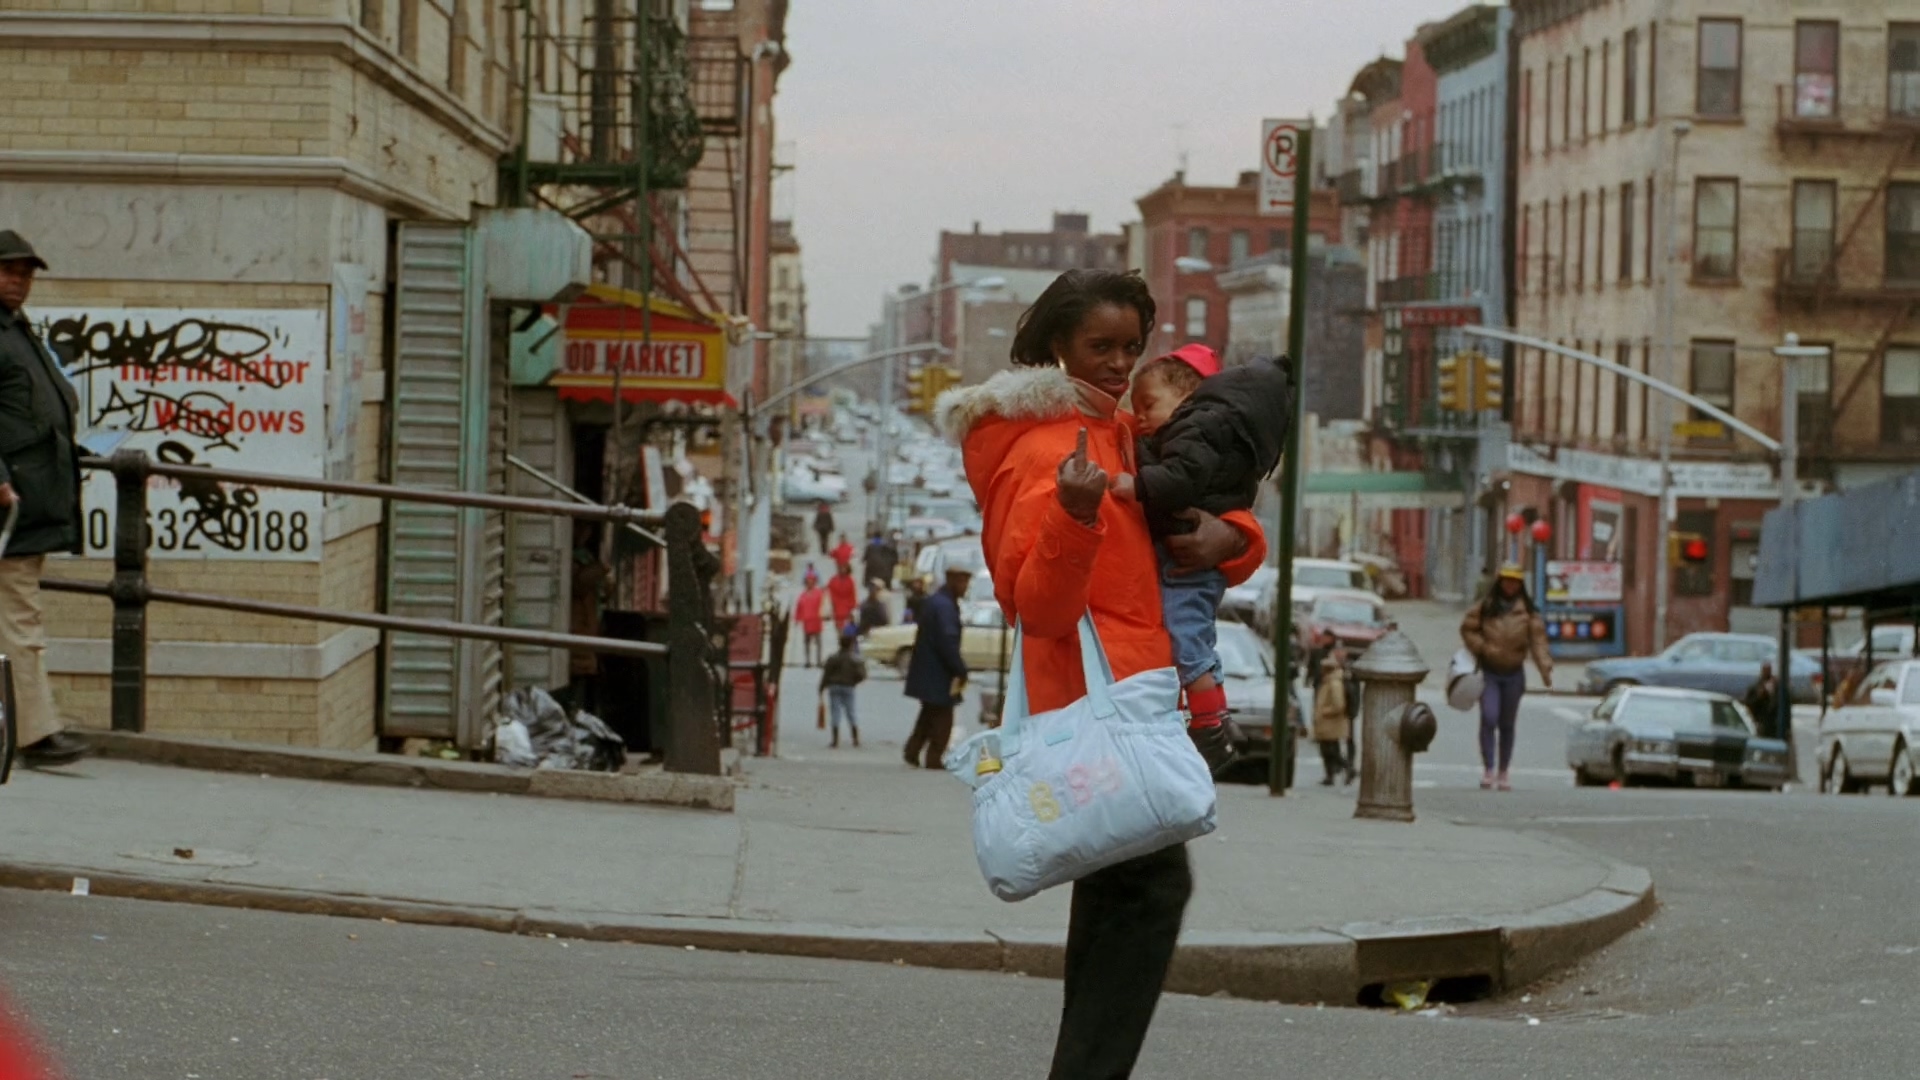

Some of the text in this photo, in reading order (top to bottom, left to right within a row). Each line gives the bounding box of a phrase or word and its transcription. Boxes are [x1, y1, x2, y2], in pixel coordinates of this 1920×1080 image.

[605, 342, 697, 375] MARKET
[154, 400, 305, 433] Windows
[146, 508, 201, 550] 32
[228, 508, 308, 551] 9188
